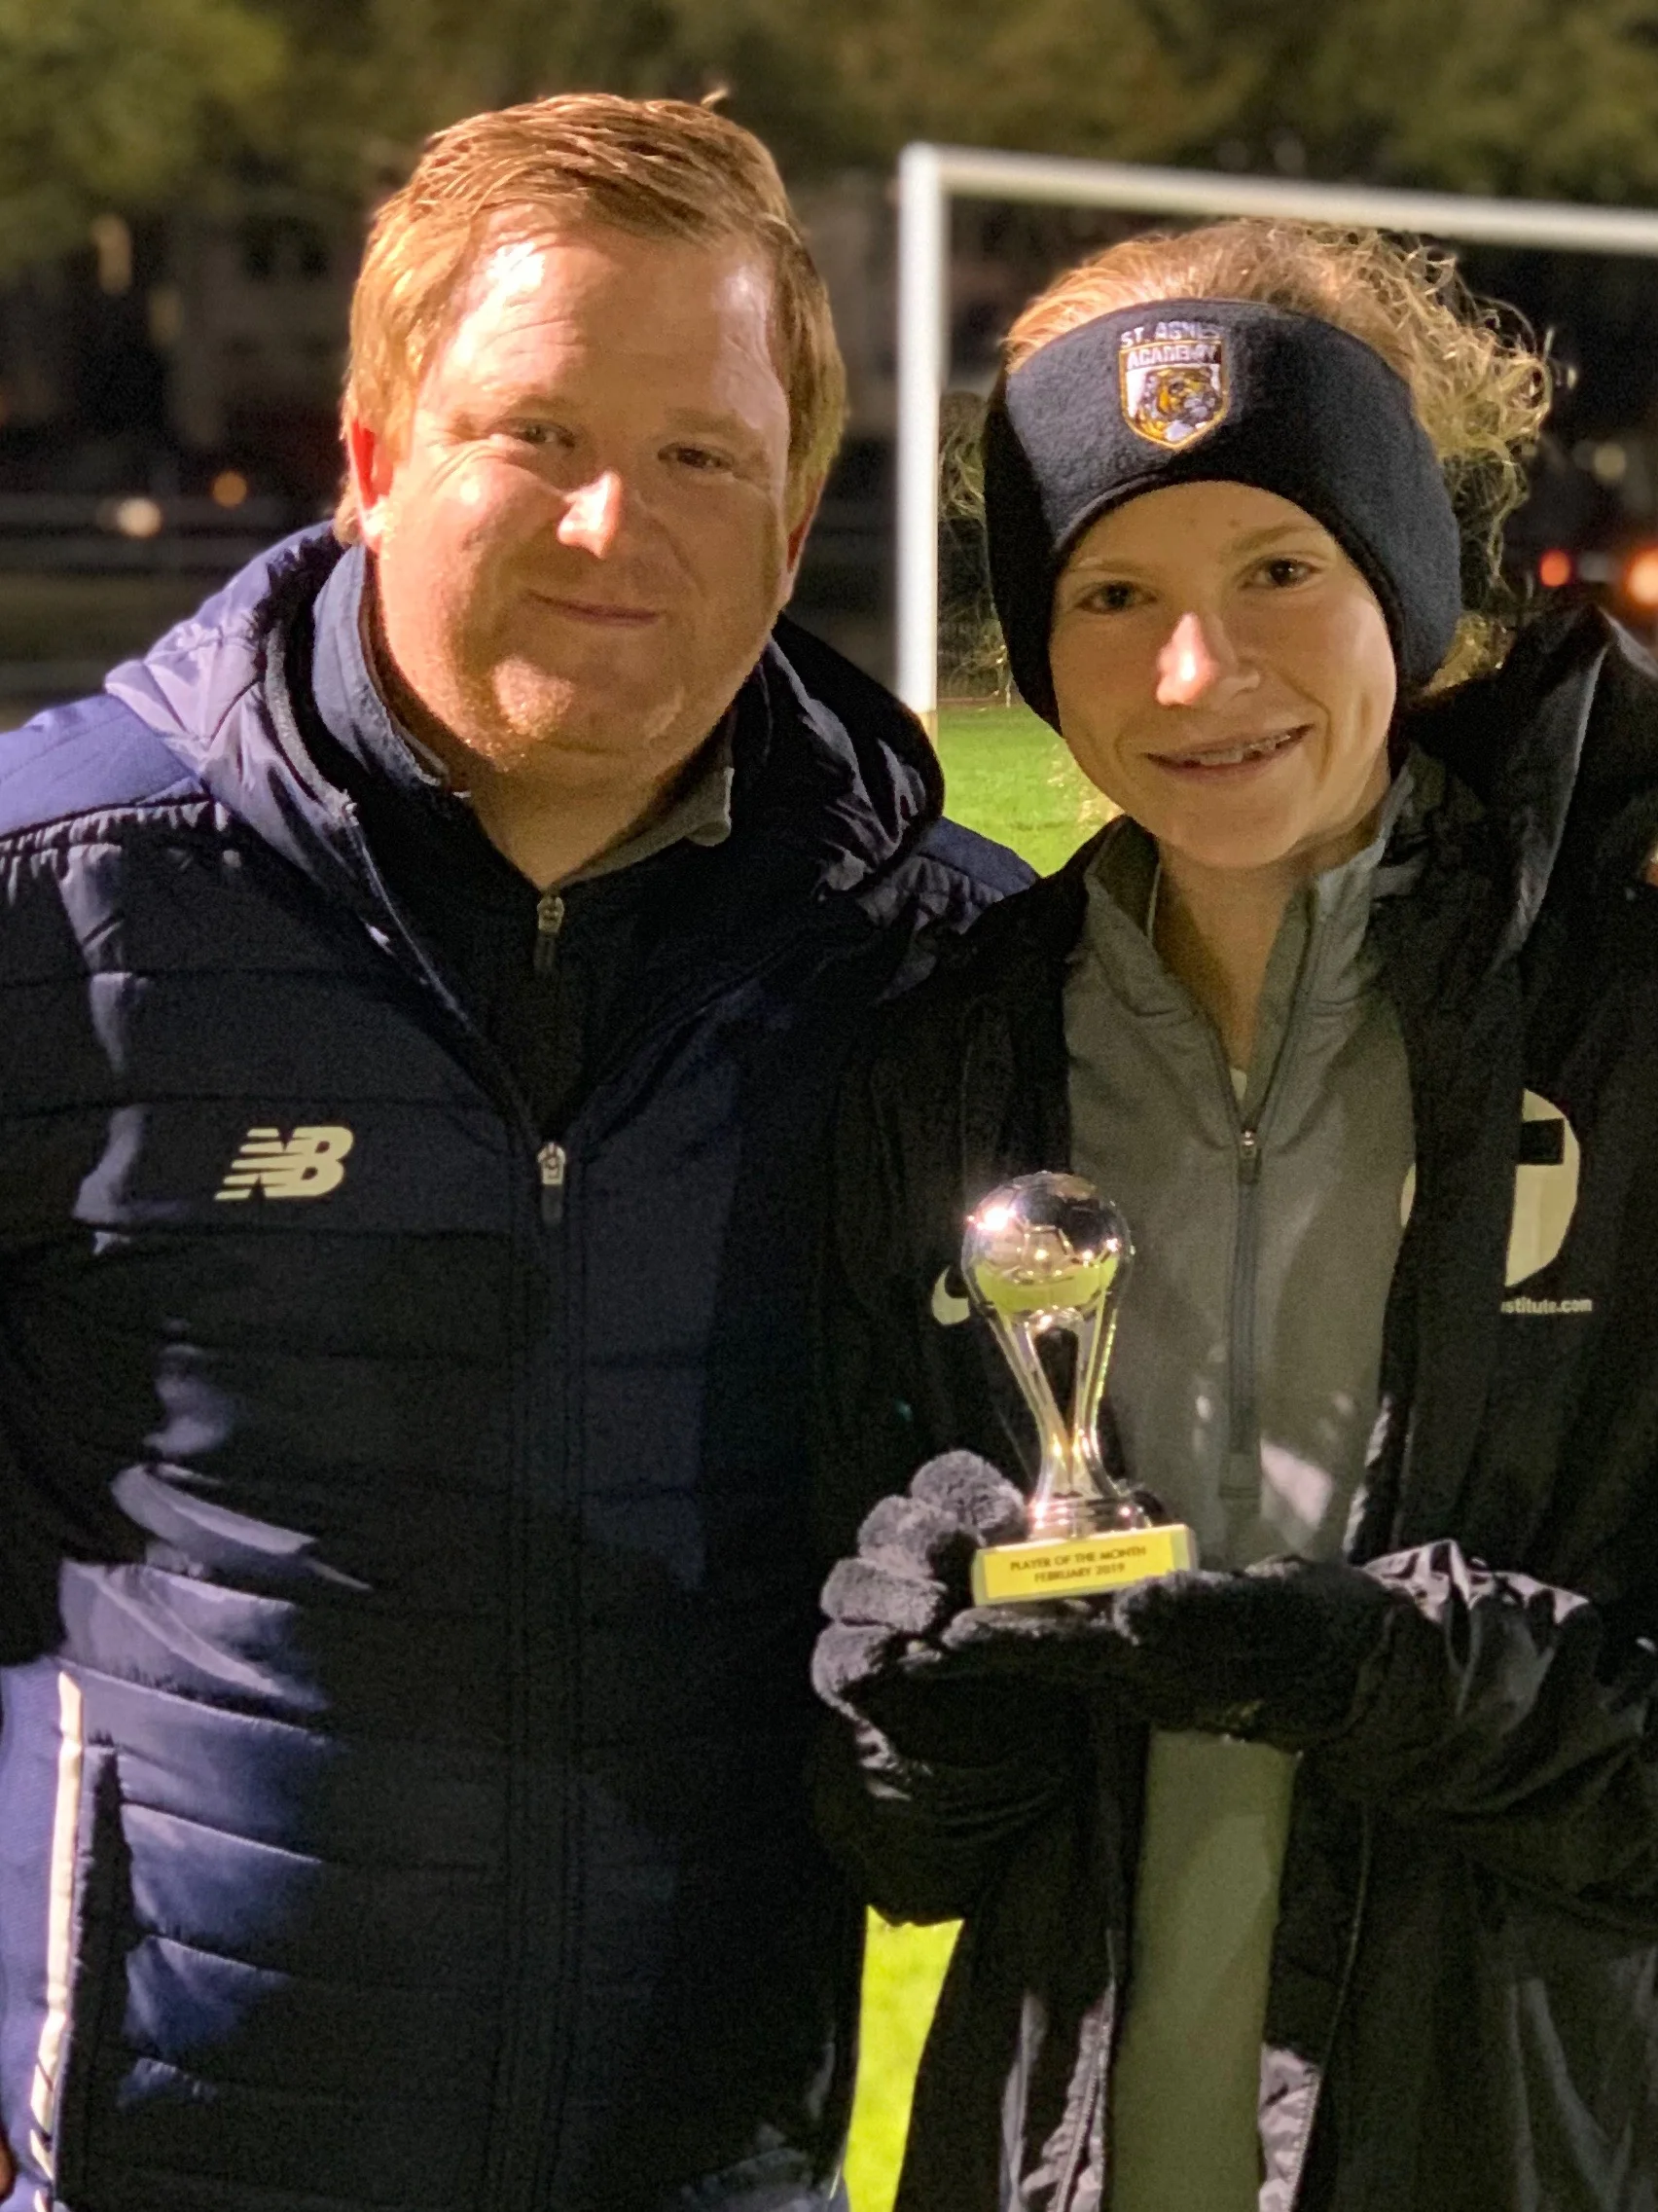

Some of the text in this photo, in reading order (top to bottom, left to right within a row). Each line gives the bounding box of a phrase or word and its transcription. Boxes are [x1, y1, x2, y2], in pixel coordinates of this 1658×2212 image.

[214, 1127, 353, 1200] NB
[1010, 1546, 1146, 1572] PLAYER OF THE MONTH
[1034, 1562, 1125, 1582] FEBRUARY 2019
